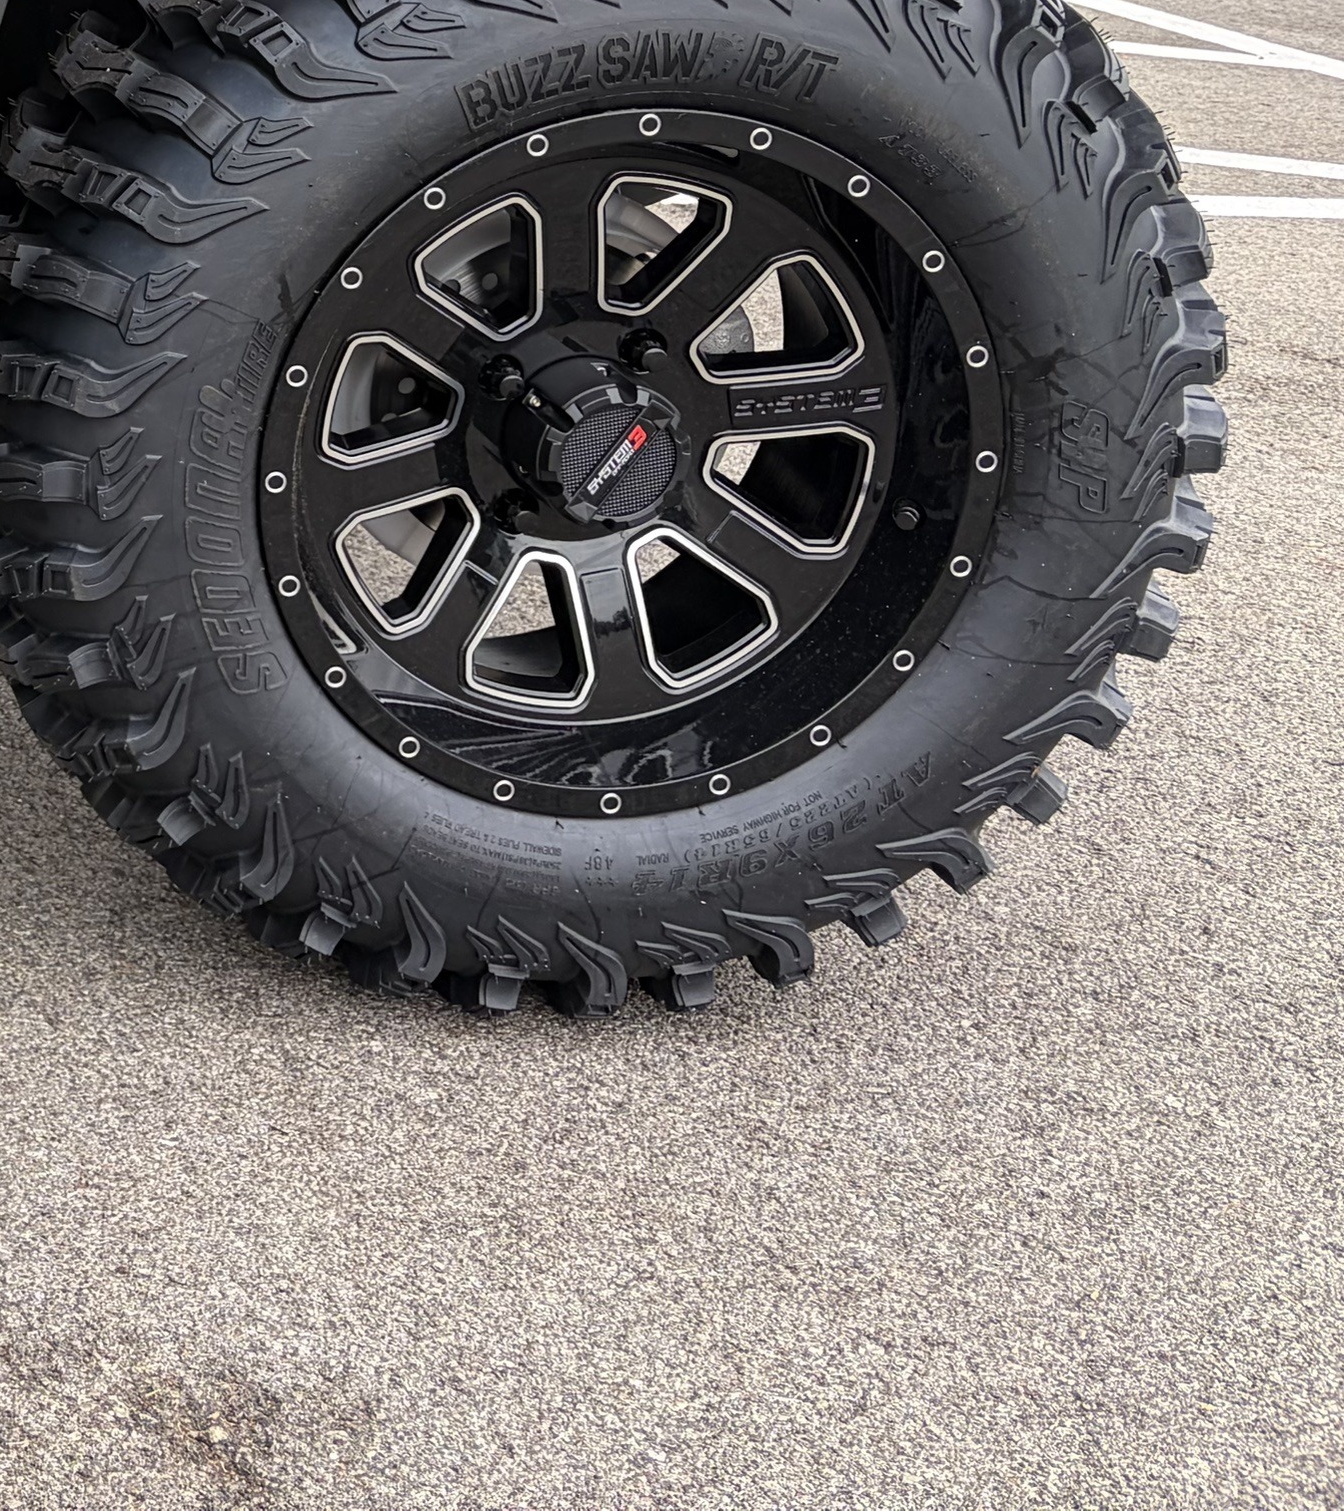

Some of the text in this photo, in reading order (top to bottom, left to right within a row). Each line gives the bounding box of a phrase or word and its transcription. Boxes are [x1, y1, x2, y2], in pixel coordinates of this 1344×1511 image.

[453, 29, 842, 132] BUZZ SAW R/T
[183, 405, 290, 689] SEDONA
[697, 788, 824, 844] NOT FOR HIGHWAY SERVICE
